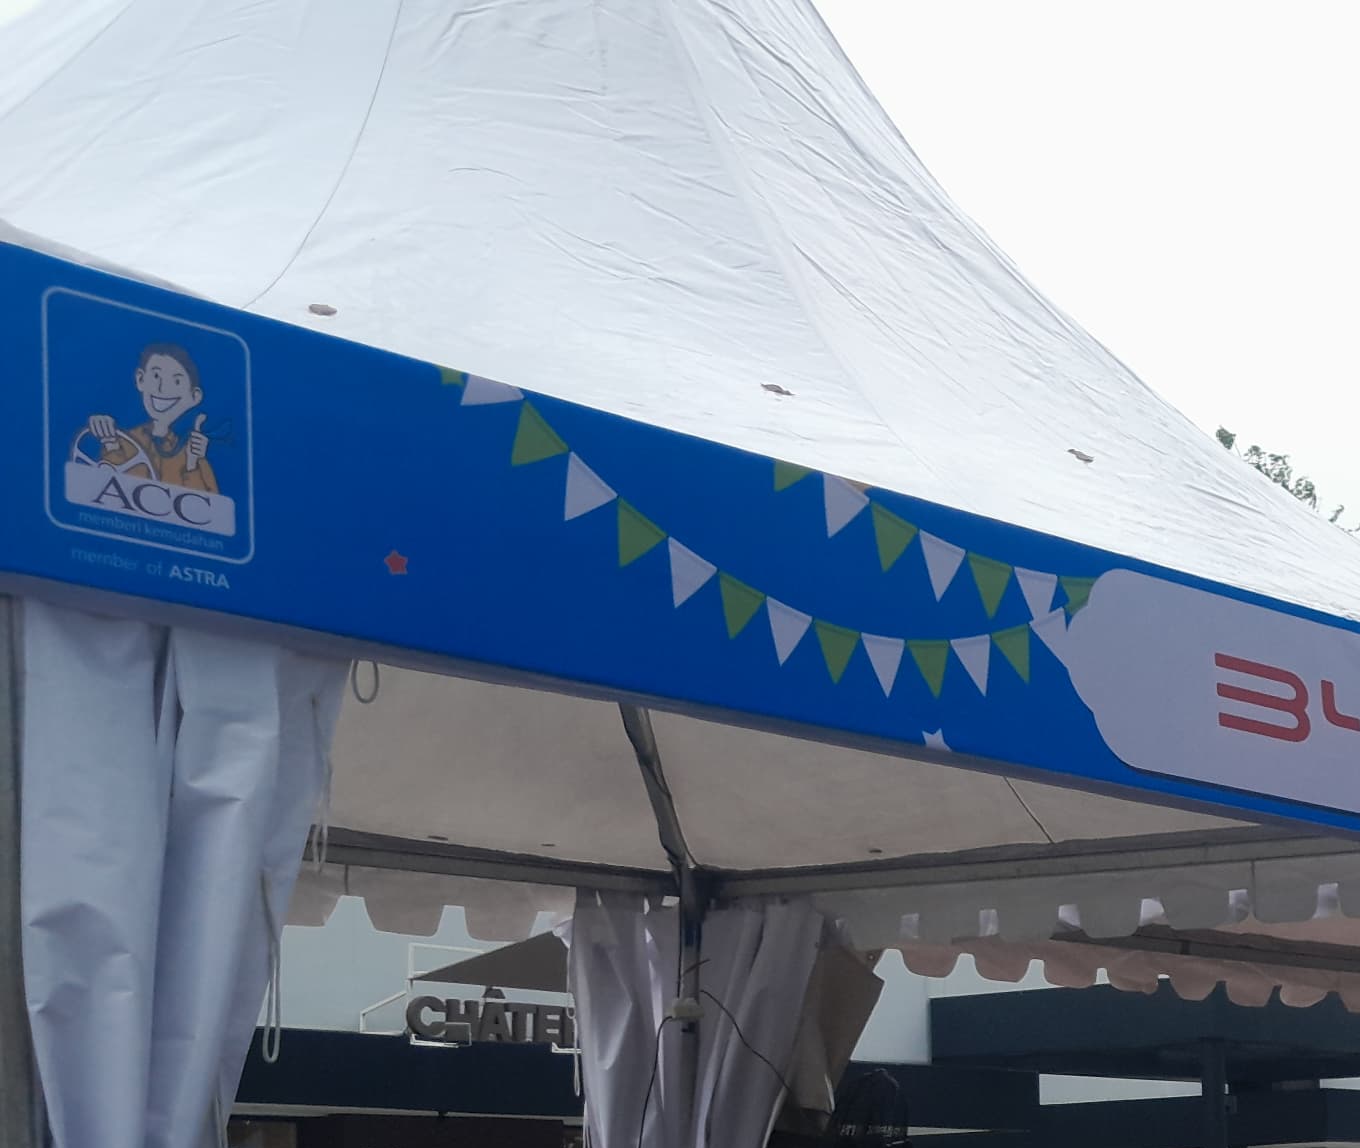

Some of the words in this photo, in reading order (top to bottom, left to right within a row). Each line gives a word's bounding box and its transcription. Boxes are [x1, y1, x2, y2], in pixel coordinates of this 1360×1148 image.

[91, 475, 212, 526] ACC
[70, 547, 139, 572] member
[145, 562, 163, 577] of
[168, 564, 231, 590] ASTRA
[405, 985, 576, 1043] CHÂTE
